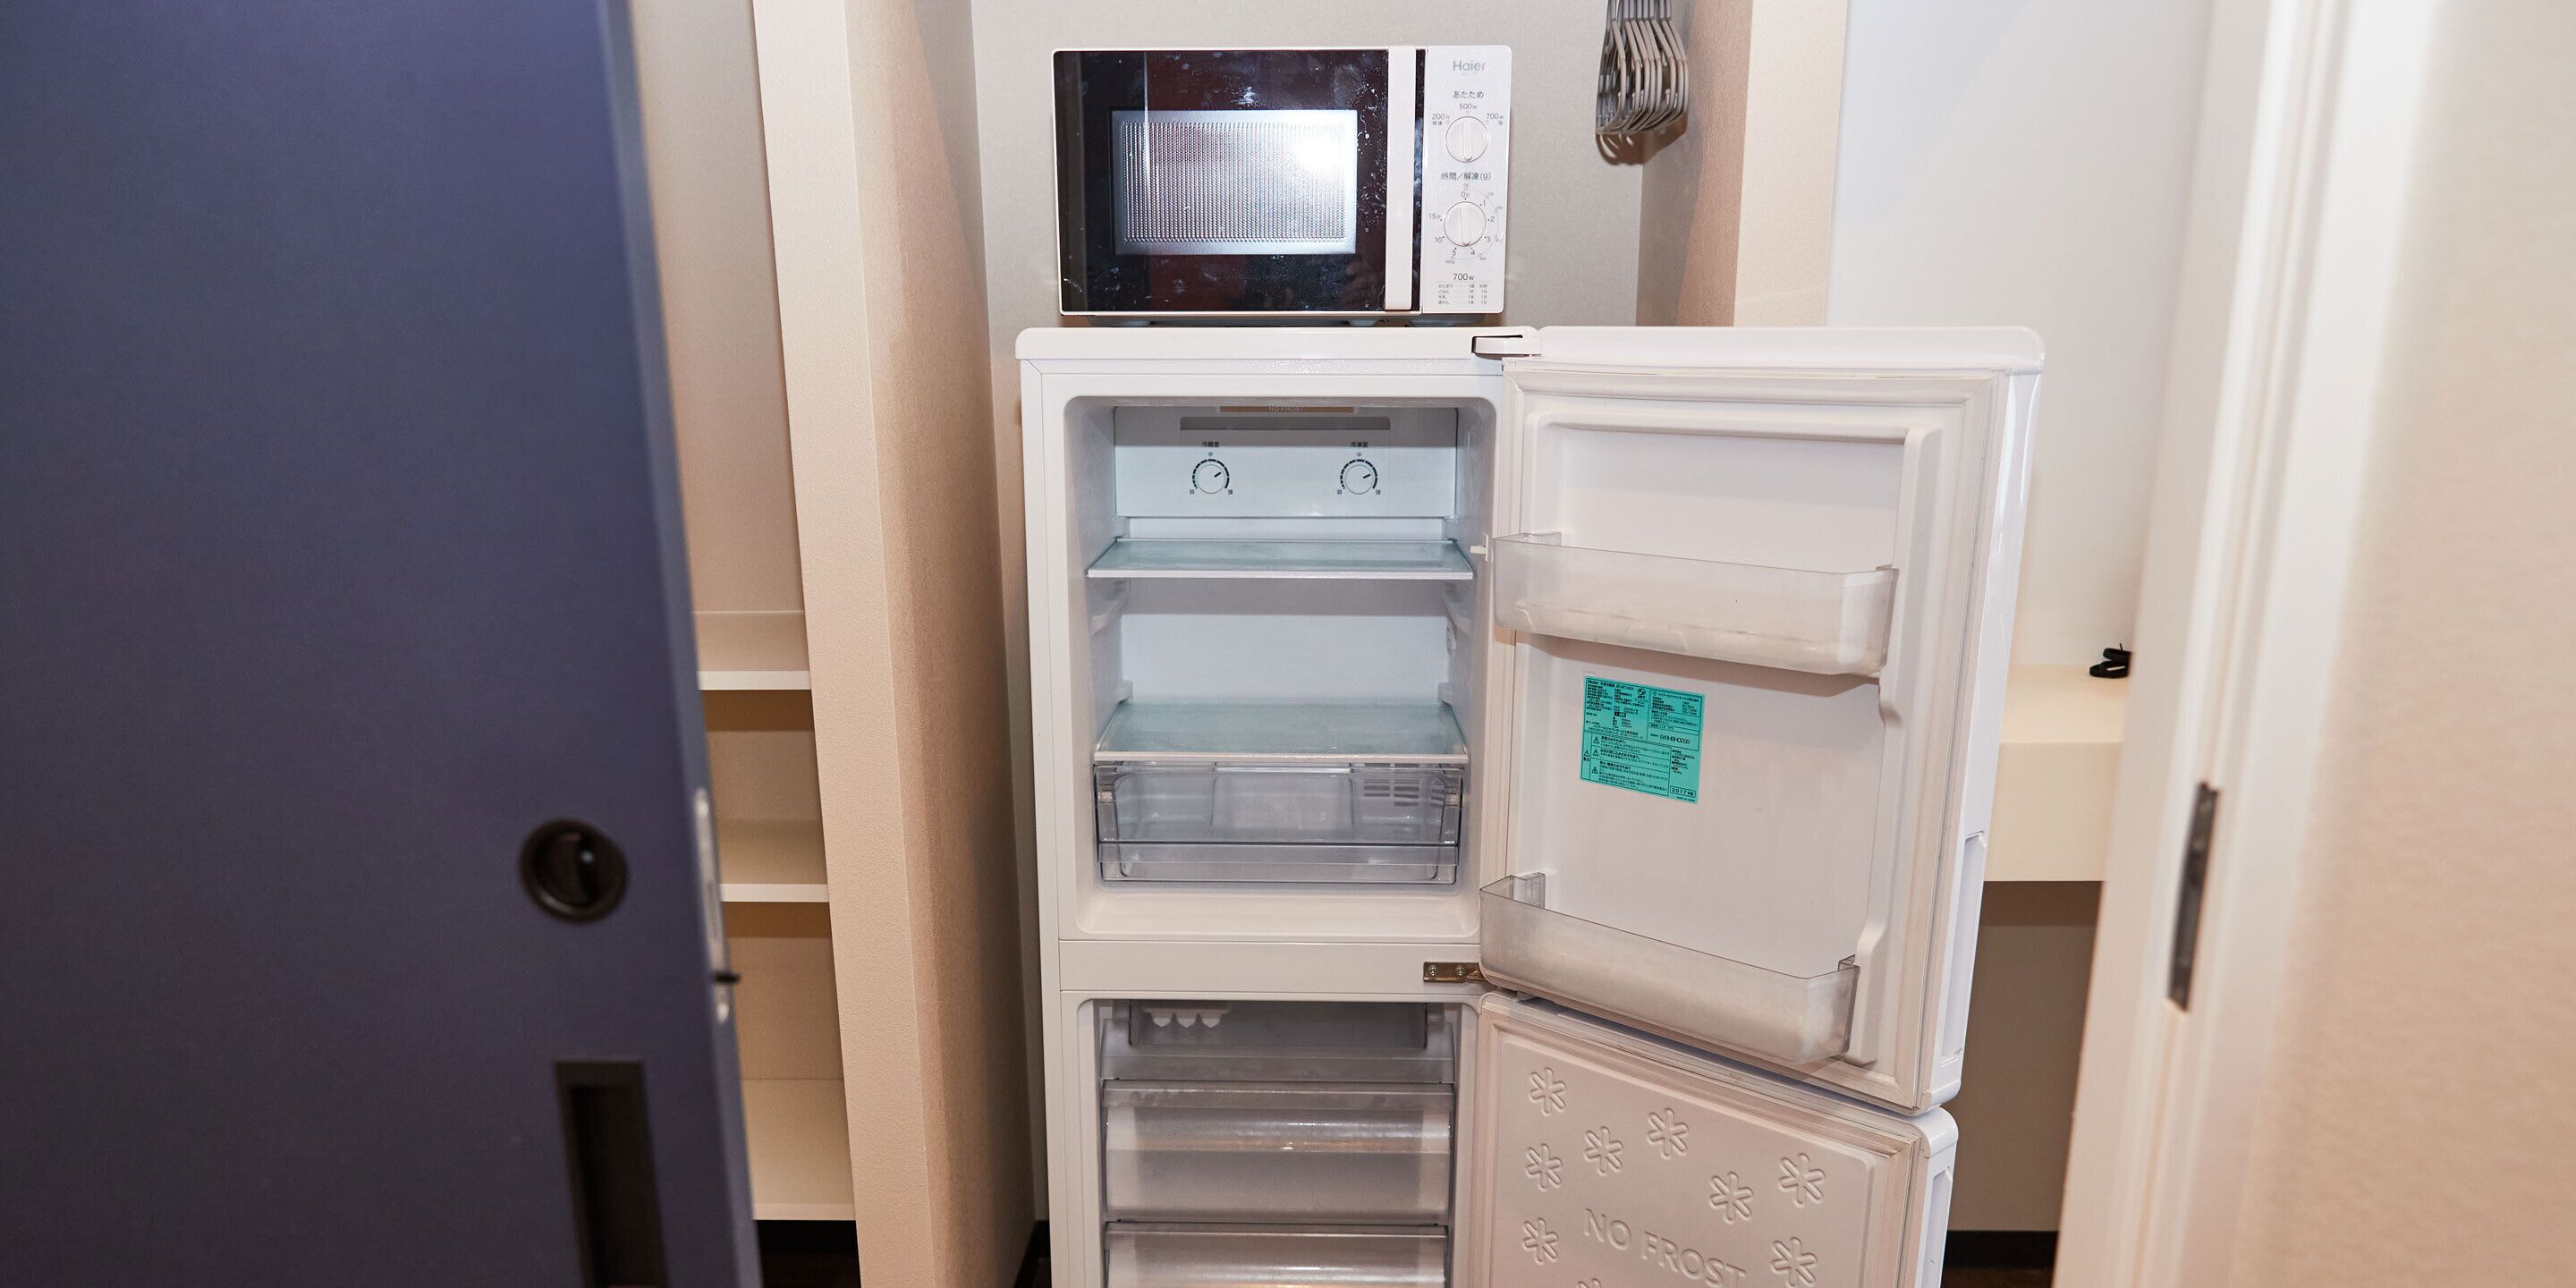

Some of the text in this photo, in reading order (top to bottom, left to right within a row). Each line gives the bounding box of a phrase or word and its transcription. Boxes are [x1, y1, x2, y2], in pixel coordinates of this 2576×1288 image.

[1453, 60, 1486, 71] Haier
[1453, 90, 1485, 99] あたため
[1582, 1208, 1747, 1288] NO FROST
